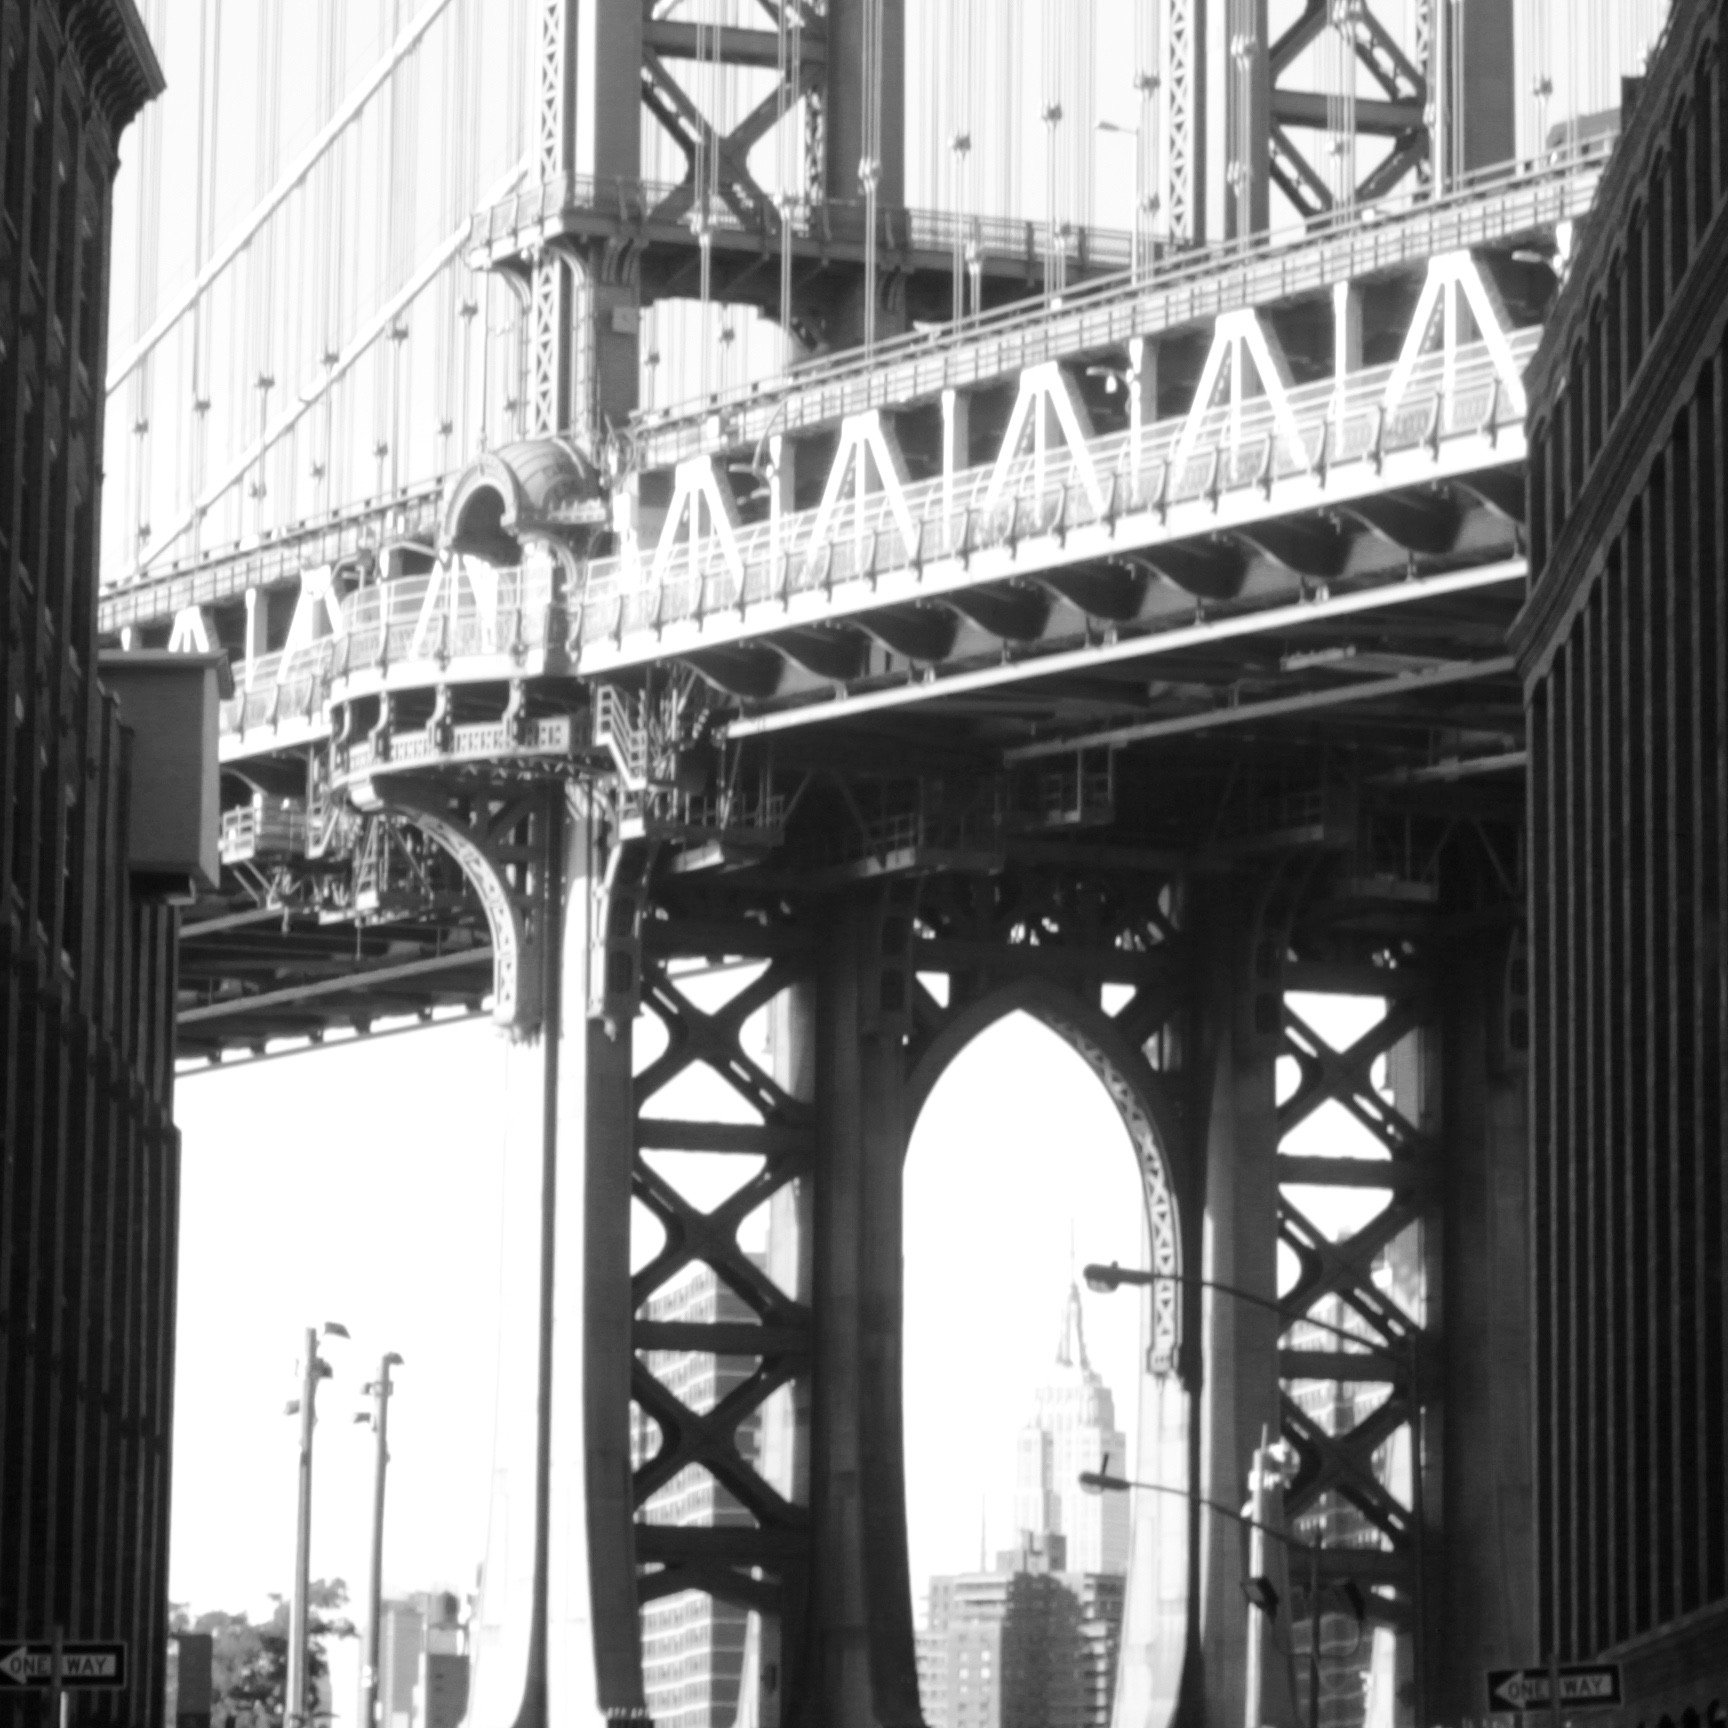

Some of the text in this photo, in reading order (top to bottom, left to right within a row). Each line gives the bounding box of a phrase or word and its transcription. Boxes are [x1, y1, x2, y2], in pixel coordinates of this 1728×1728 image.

[10, 1655, 107, 1674] ONE WAY
[1563, 1676, 1603, 1696] WAY
